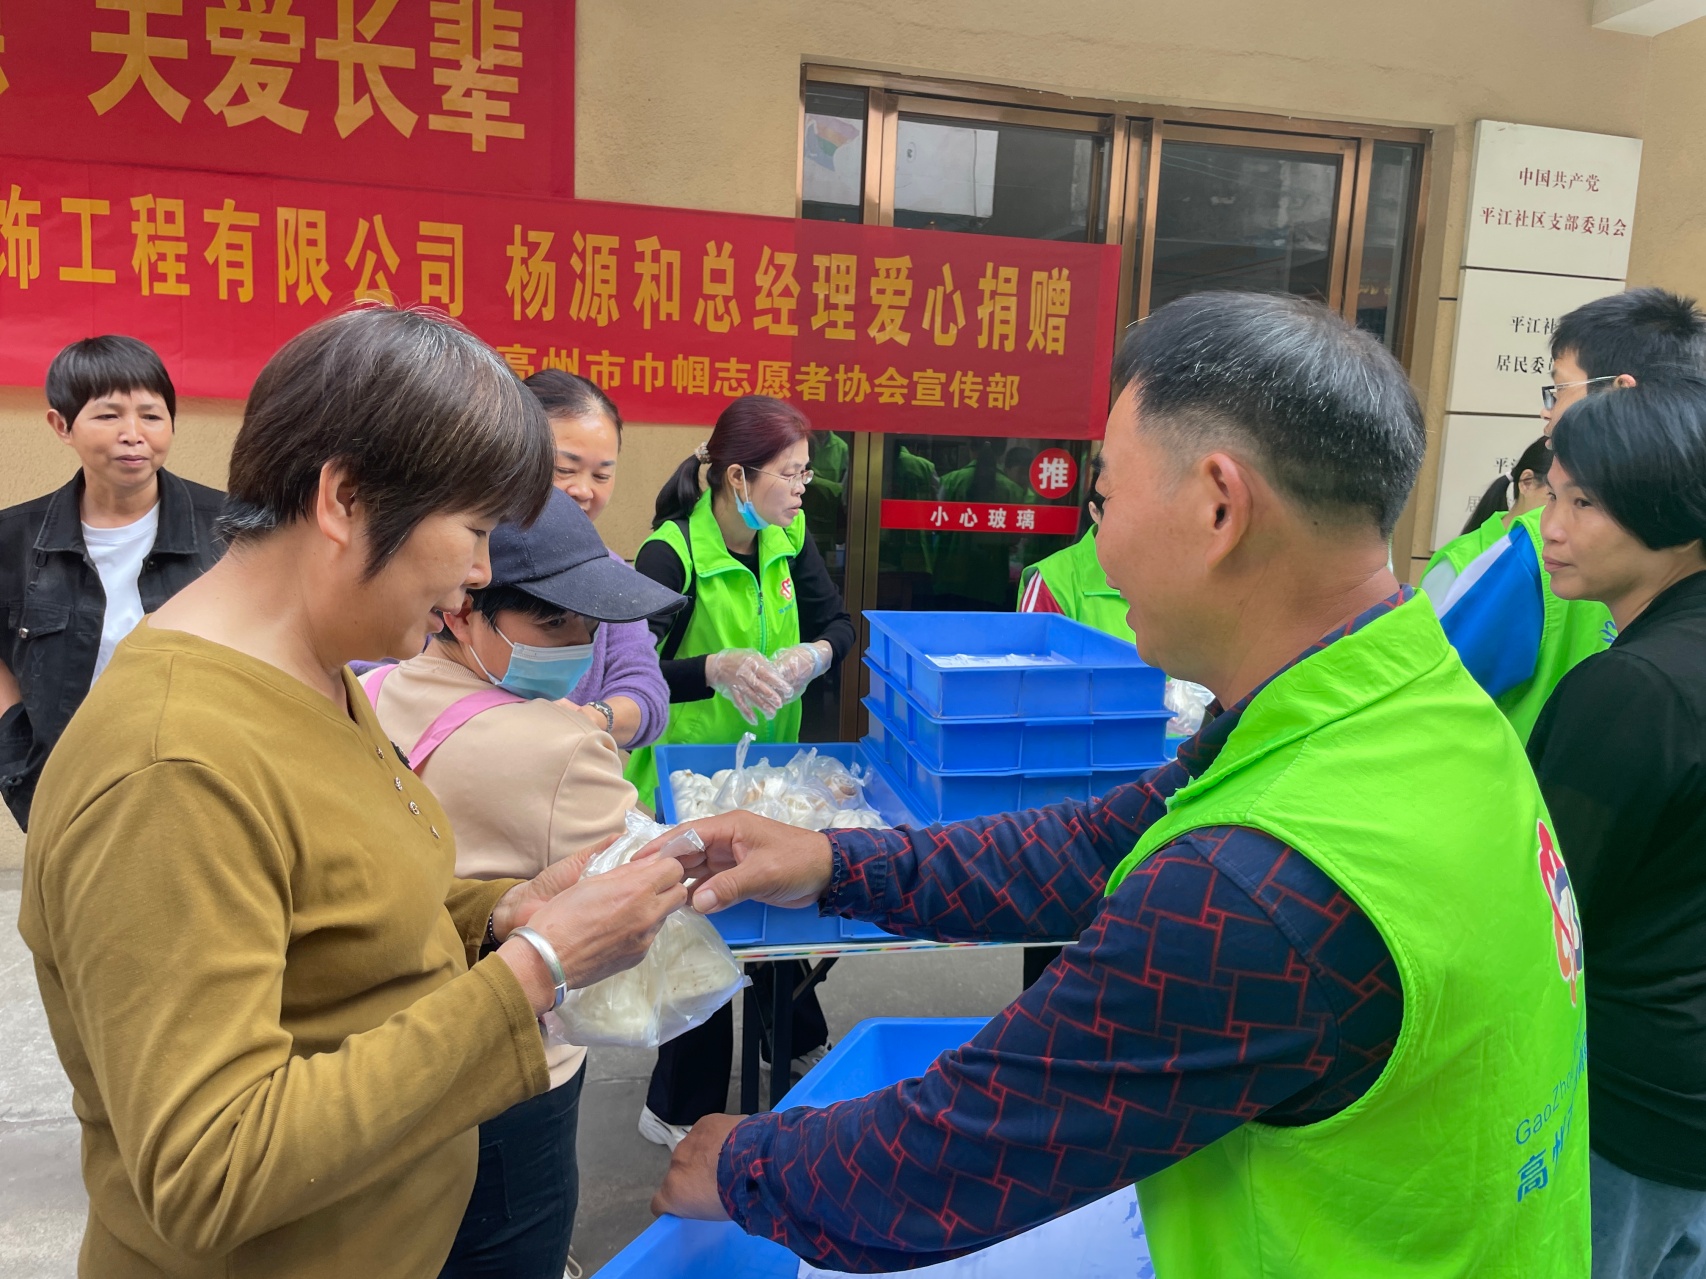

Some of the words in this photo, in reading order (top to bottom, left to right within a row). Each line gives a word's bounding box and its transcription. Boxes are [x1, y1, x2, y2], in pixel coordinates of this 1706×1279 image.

[1519, 167, 1600, 192] 中国共产党
[1480, 207, 1627, 237] 平江社区支部委员会
[506, 224, 1072, 356] 杨源和总经理爱心捐赠
[1496, 354, 1553, 374] 居民委
[1038, 457, 1069, 490] 推
[930, 506, 1036, 530] 小心玻璃
